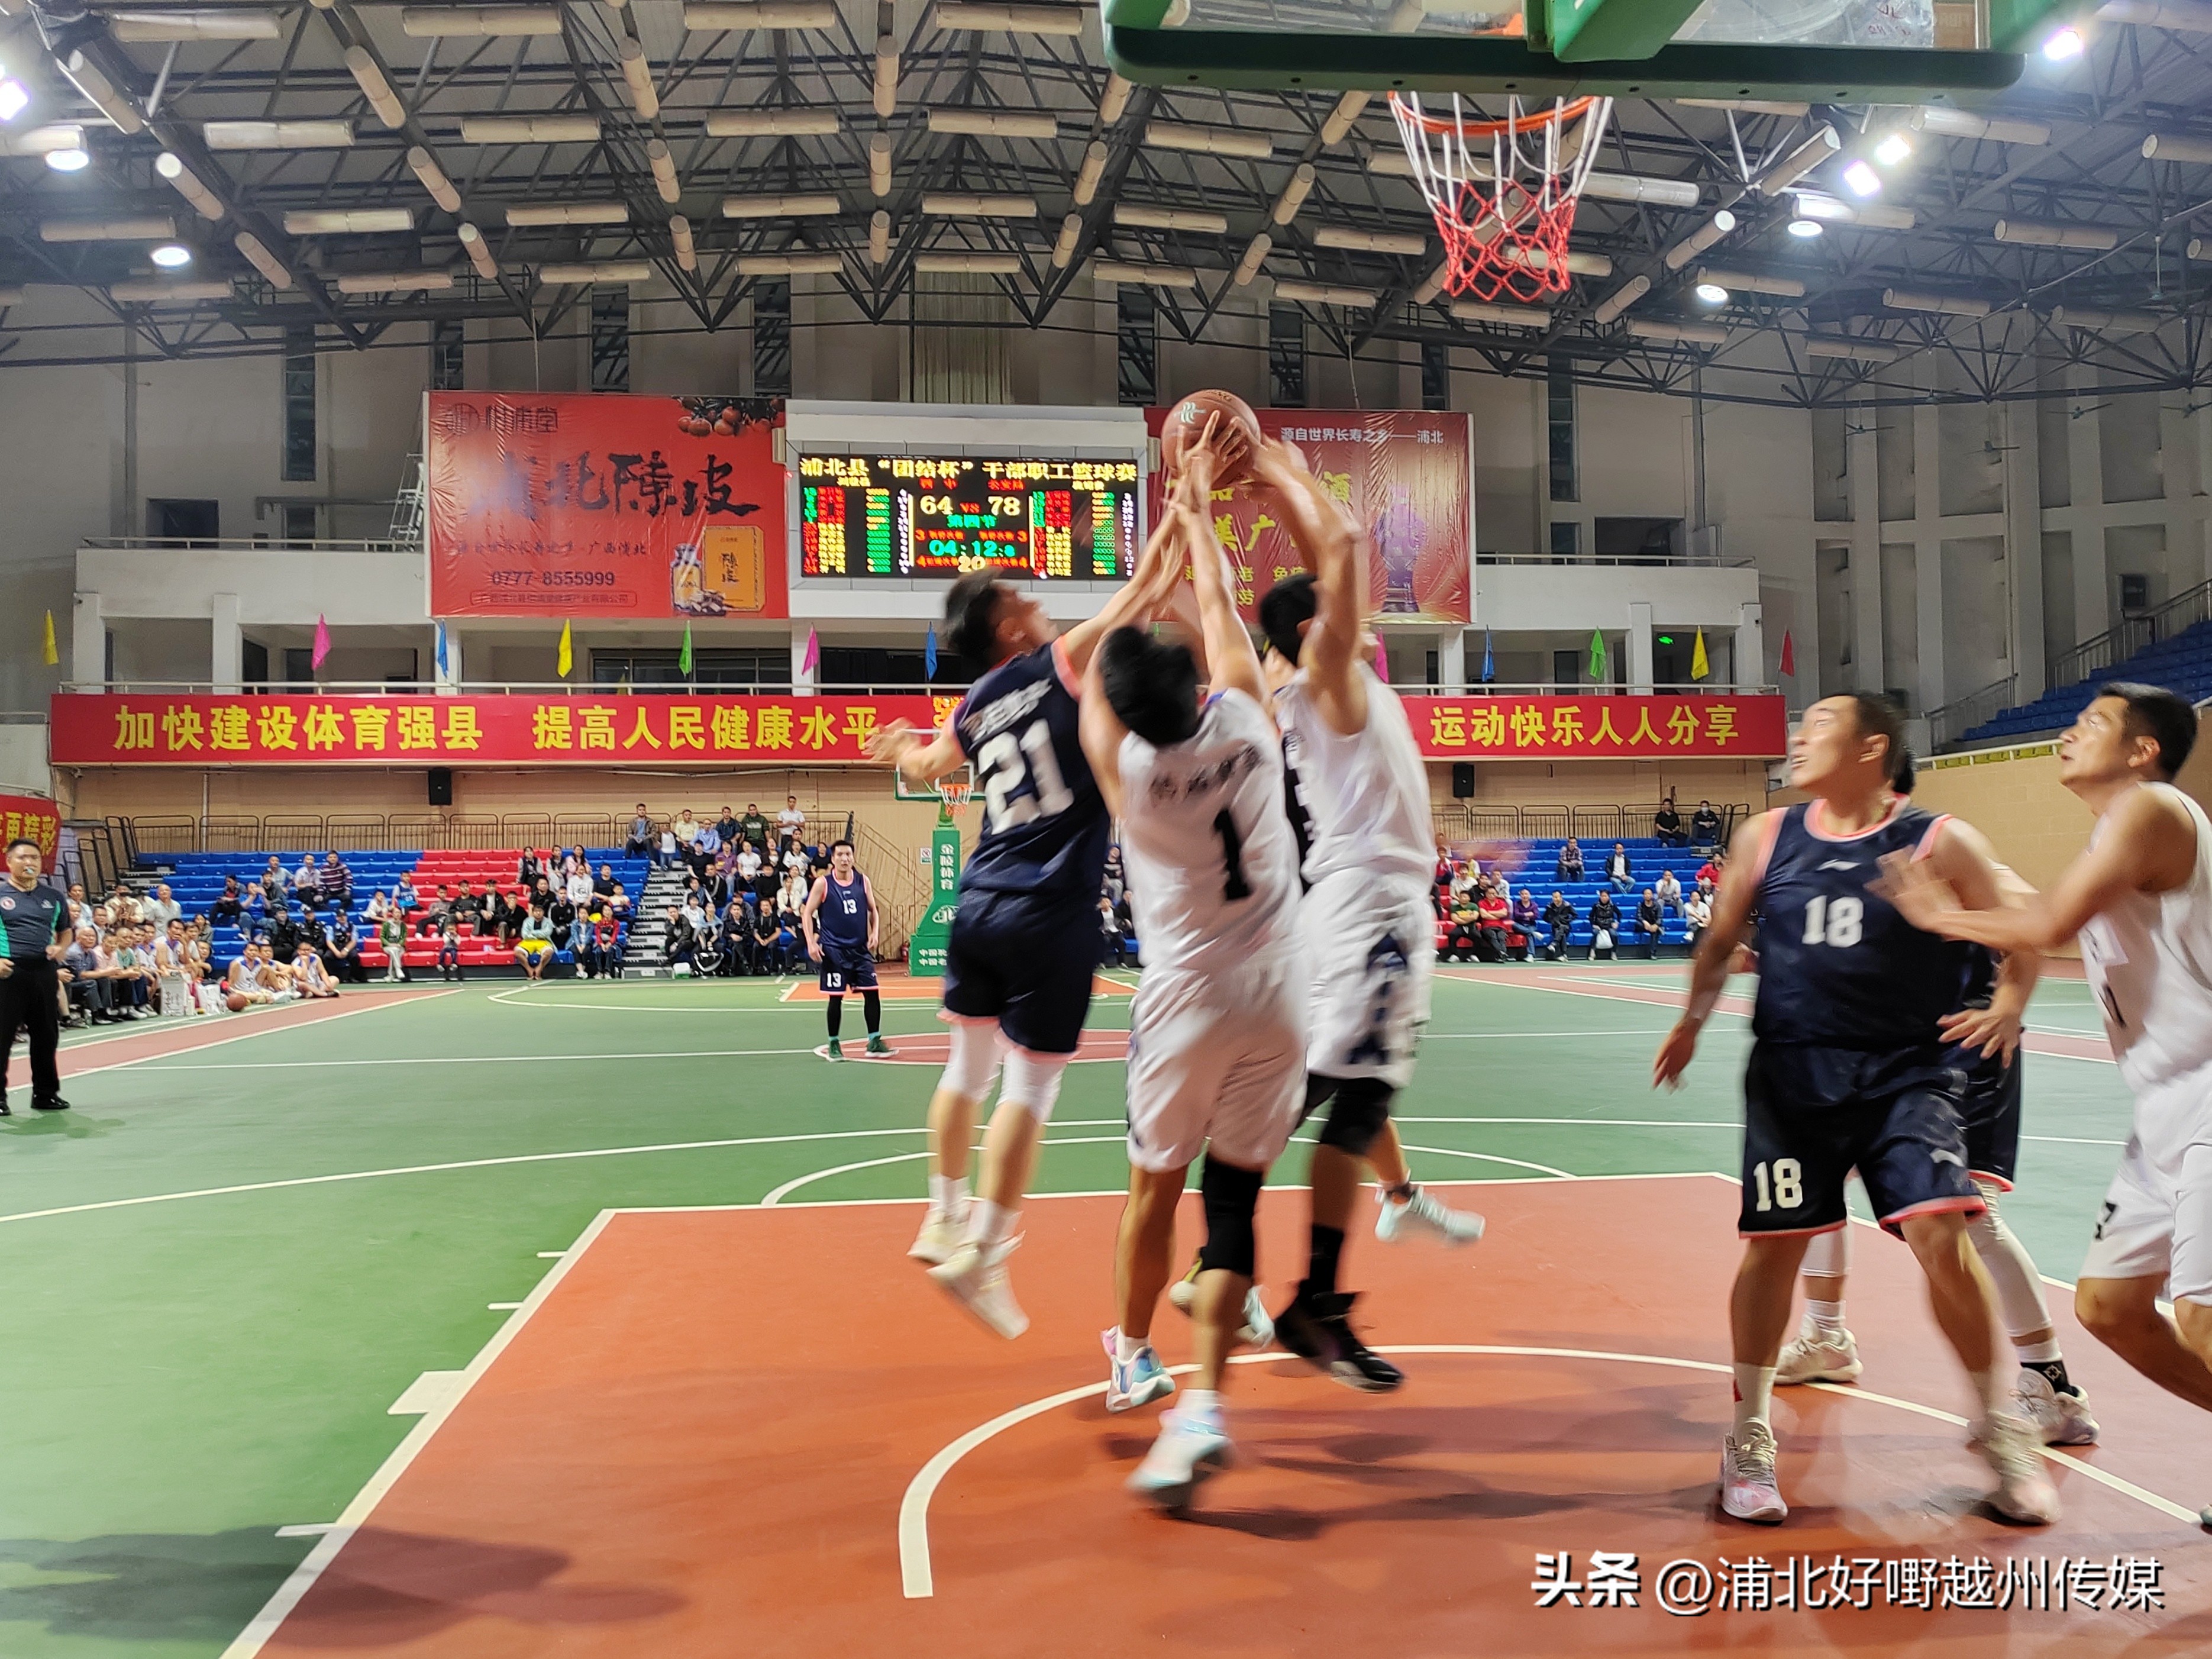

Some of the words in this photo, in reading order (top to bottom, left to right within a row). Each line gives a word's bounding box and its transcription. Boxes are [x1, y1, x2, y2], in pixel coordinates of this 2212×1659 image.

[800, 457, 870, 477] 浦北县
[982, 461, 1138, 482] 干部职工篮球赛
[920, 495, 953, 515] 64
[987, 496, 1021, 516] 78
[957, 555, 986, 573] 20
[114, 705, 483, 751] 加快建设体育强县
[532, 703, 880, 751] 提高人民健康水平
[1430, 704, 1739, 747] 运动快乐人人分享
[978, 718, 1074, 835] 21
[0, 811, 56, 856] 更精彩
[1214, 808, 1251, 900] 1
[842, 899, 857, 914] 13
[1801, 895, 1864, 947] 18
[826, 972, 841, 987] 13
[1753, 1158, 1803, 1212] 18
